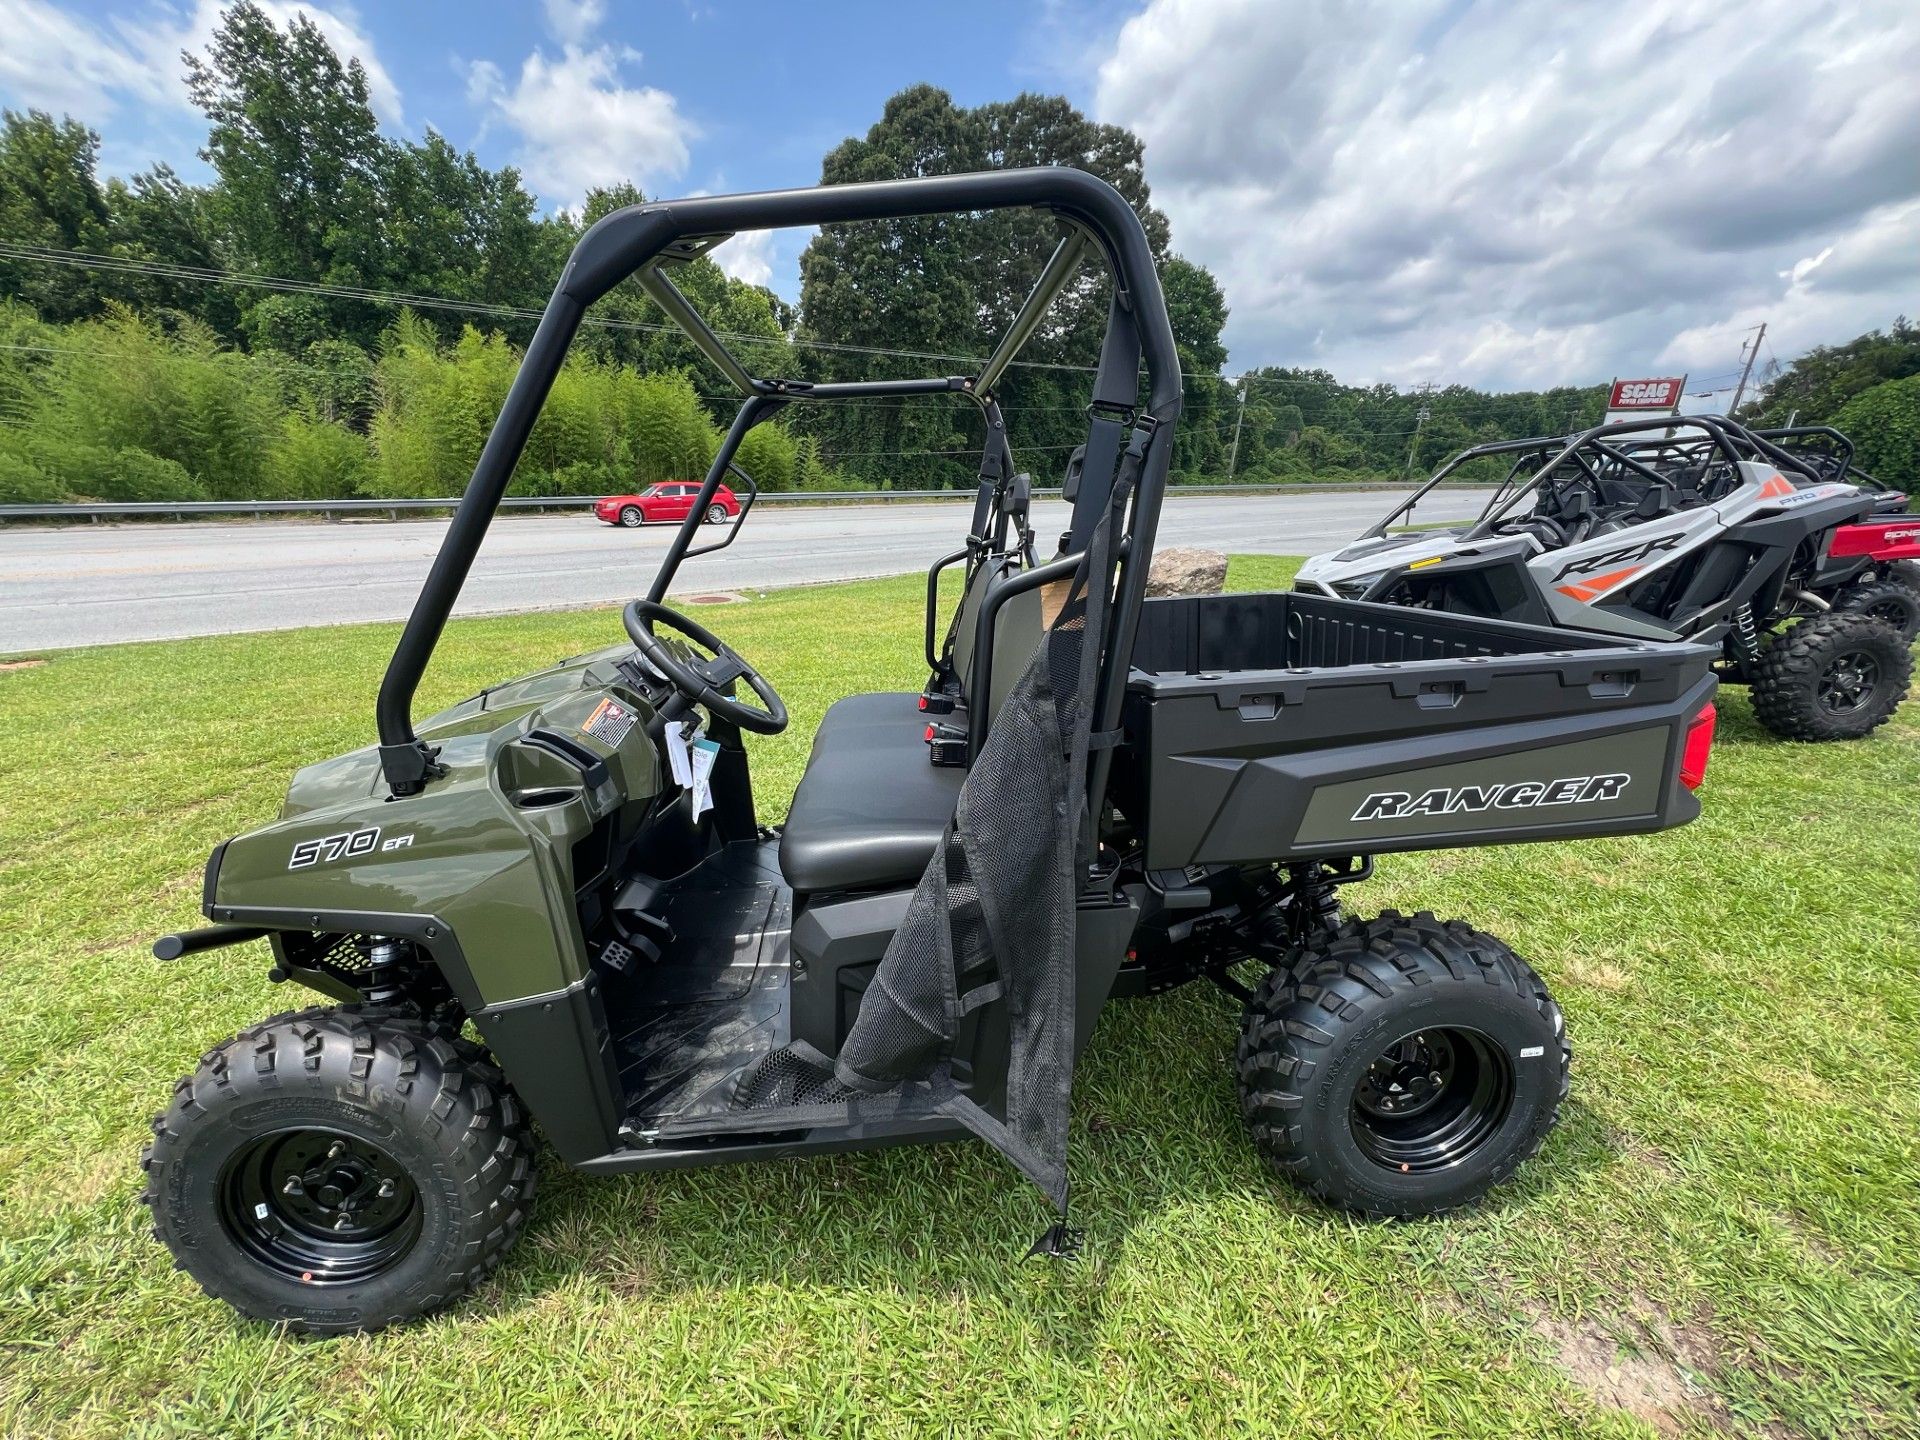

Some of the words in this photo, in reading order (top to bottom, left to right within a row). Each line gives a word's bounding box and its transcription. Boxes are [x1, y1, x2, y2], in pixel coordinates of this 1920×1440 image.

[1620, 383, 1671, 398] SCAG
[1779, 492, 1816, 506] PRO
[1549, 532, 1687, 584] RZR
[1350, 773, 1631, 821] RANGER
[288, 826, 382, 870] 570
[382, 834, 415, 852] EFI
